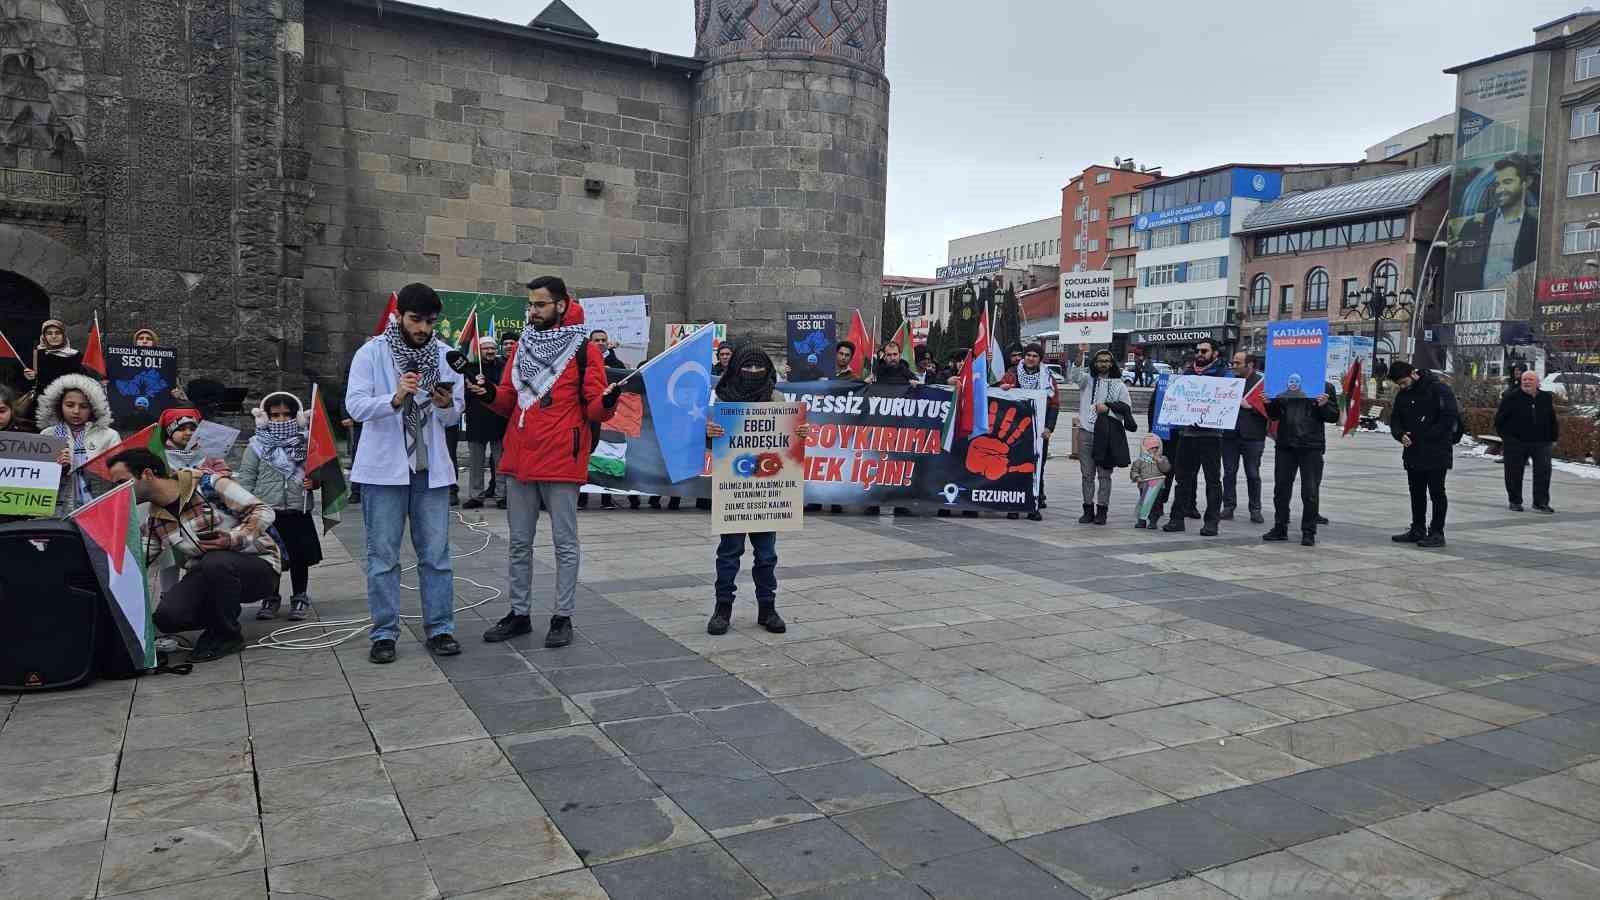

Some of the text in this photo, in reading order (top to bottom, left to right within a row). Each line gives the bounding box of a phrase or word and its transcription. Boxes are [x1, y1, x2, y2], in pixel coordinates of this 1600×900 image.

[1064, 277, 1109, 286] ÇOCUKLARIN
[1064, 286, 1109, 299] ÖLMEDİĞİ
[1063, 309, 1087, 321] SESİ
[796, 320, 826, 330] SES OL!
[1148, 331, 1211, 342] EROL COLLECTION
[121, 355, 162, 368] SES OL!
[801, 391, 864, 414] SESSİZ
[744, 416, 775, 432] EBEDİ
[729, 432, 790, 449] KARDEŞLİK
[804, 424, 941, 454] SOYKIRIMA
[0, 466, 41, 479] WITH
[851, 449, 914, 491] İÇİN!
[971, 489, 1026, 504] ERZURUM
